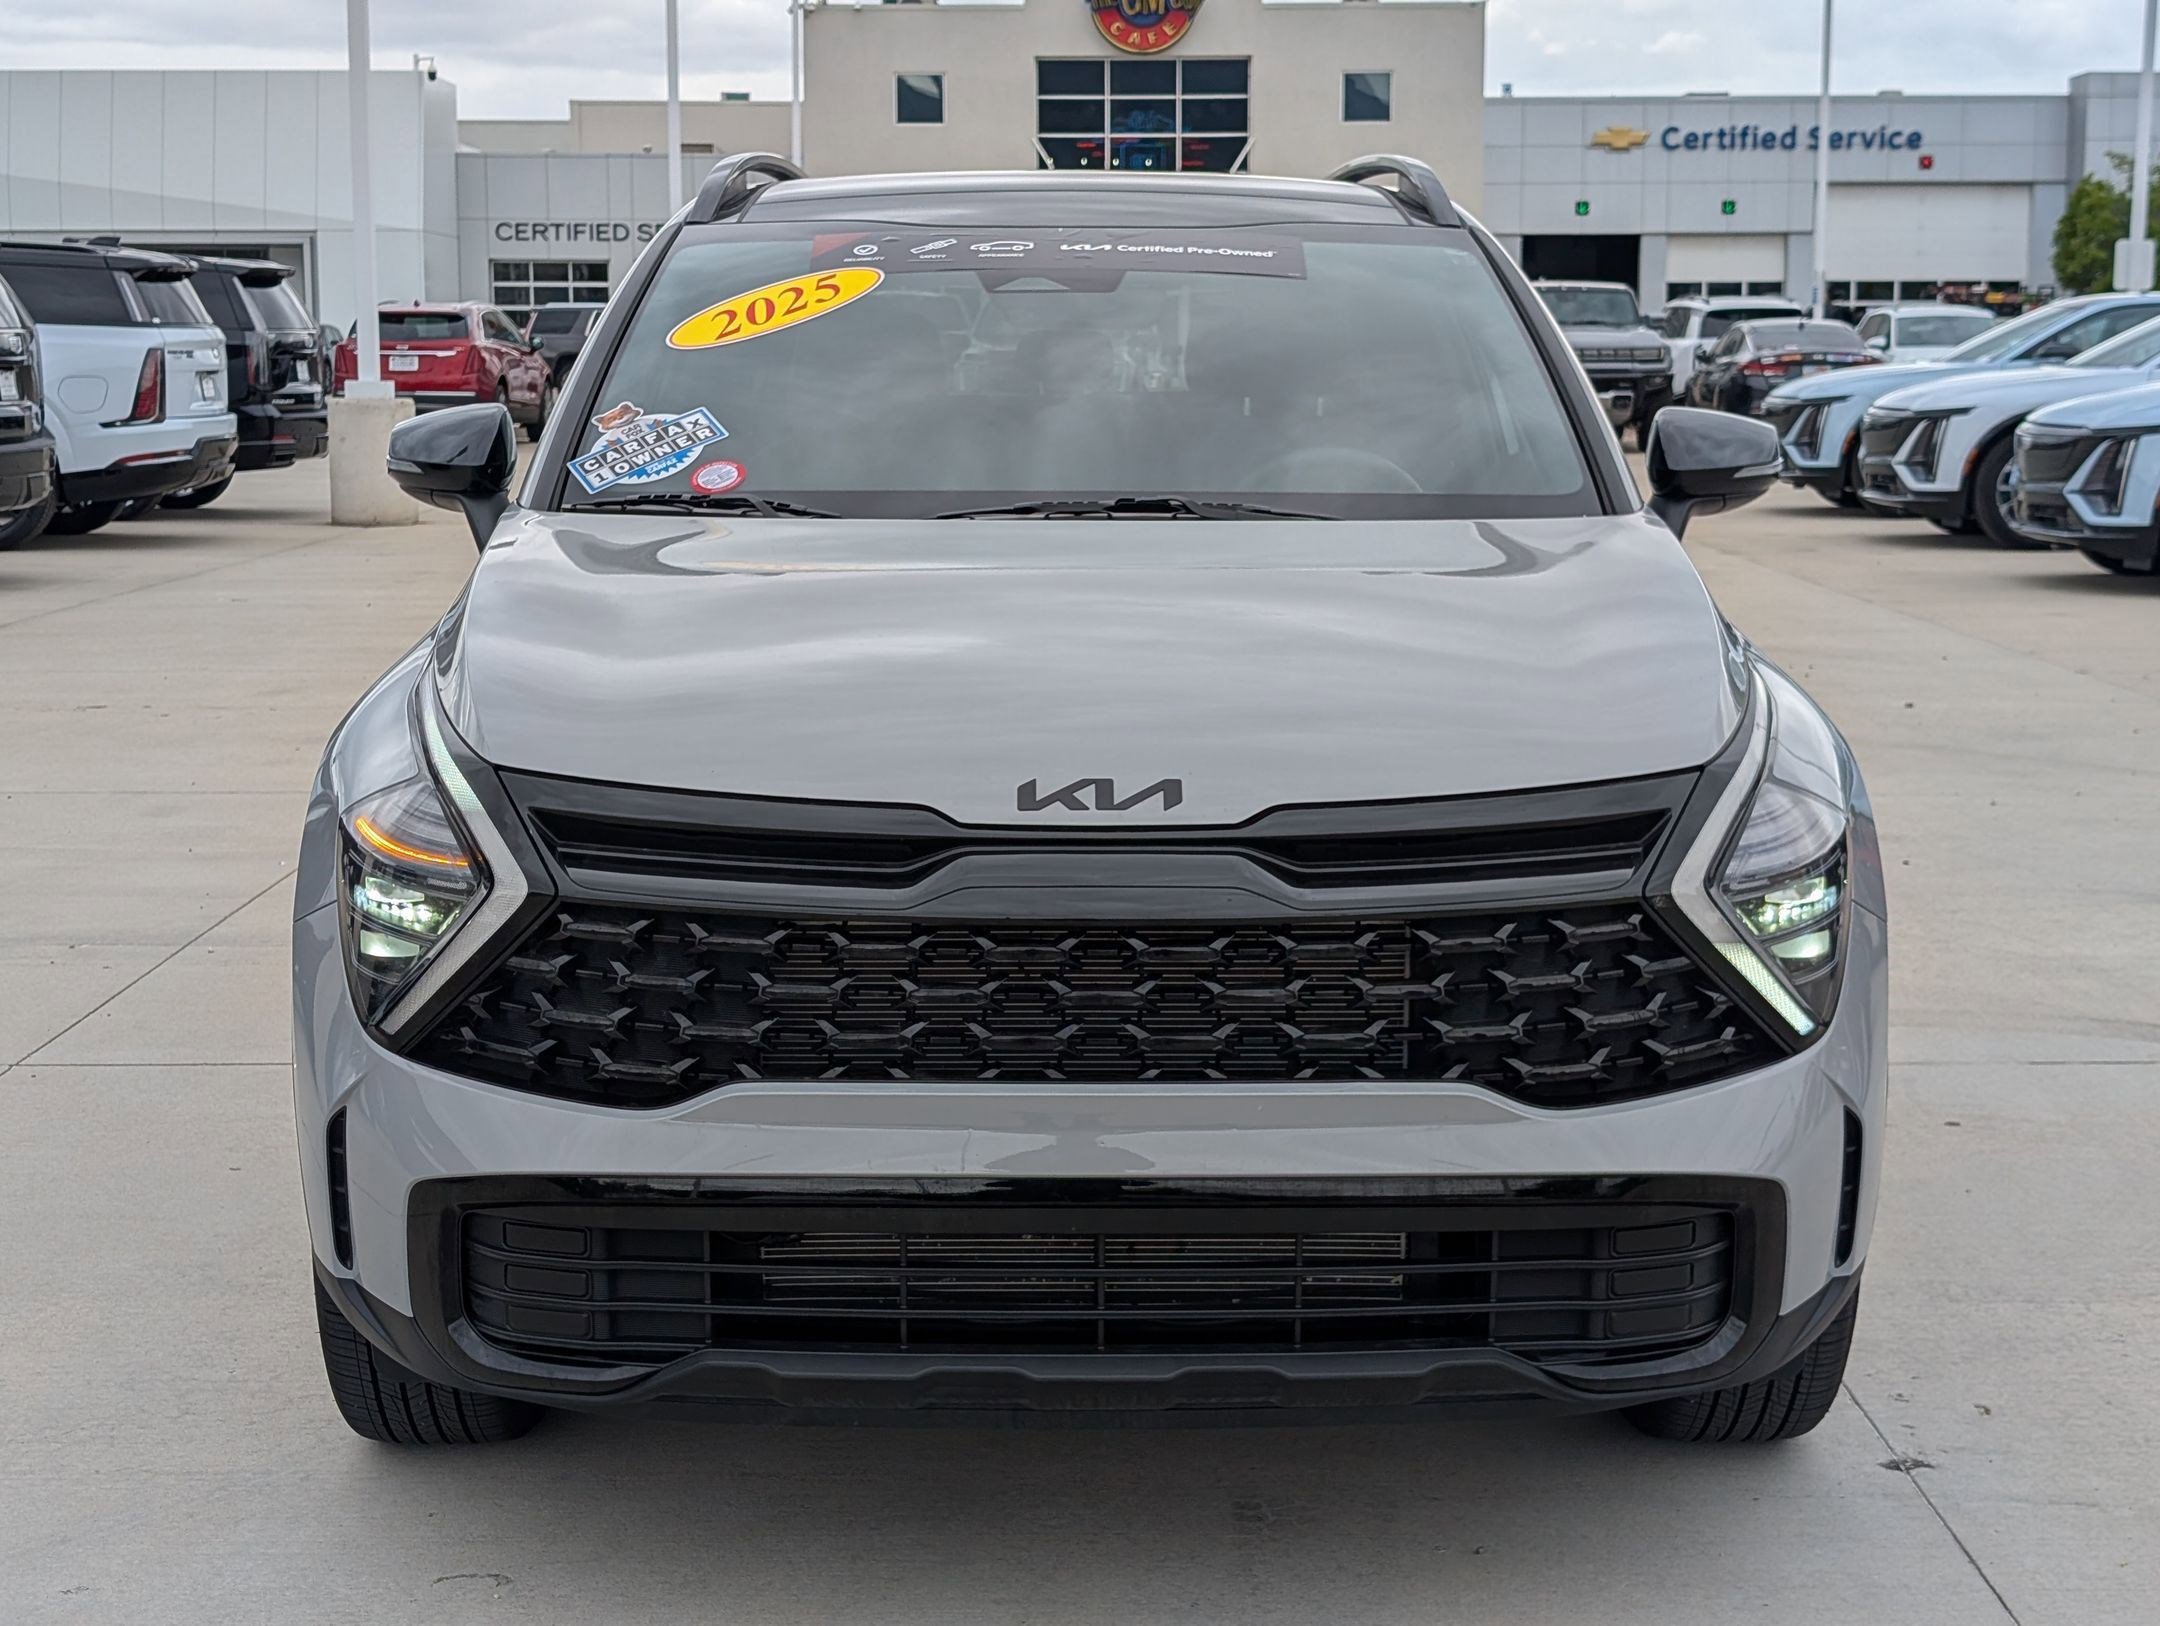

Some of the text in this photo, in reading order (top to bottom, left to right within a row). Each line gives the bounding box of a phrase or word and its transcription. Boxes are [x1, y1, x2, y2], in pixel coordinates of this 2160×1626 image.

[1110, 22, 1177, 44] CAFE
[1661, 126, 1922, 150] Certified Service
[495, 222, 630, 242] CERTIFIED
[1117, 244, 1184, 253] Certified
[711, 273, 841, 341] 2025
[583, 417, 702, 472] CARFAX
[593, 428, 713, 484] 1 OWNER
[1017, 778, 1183, 812] KIA
